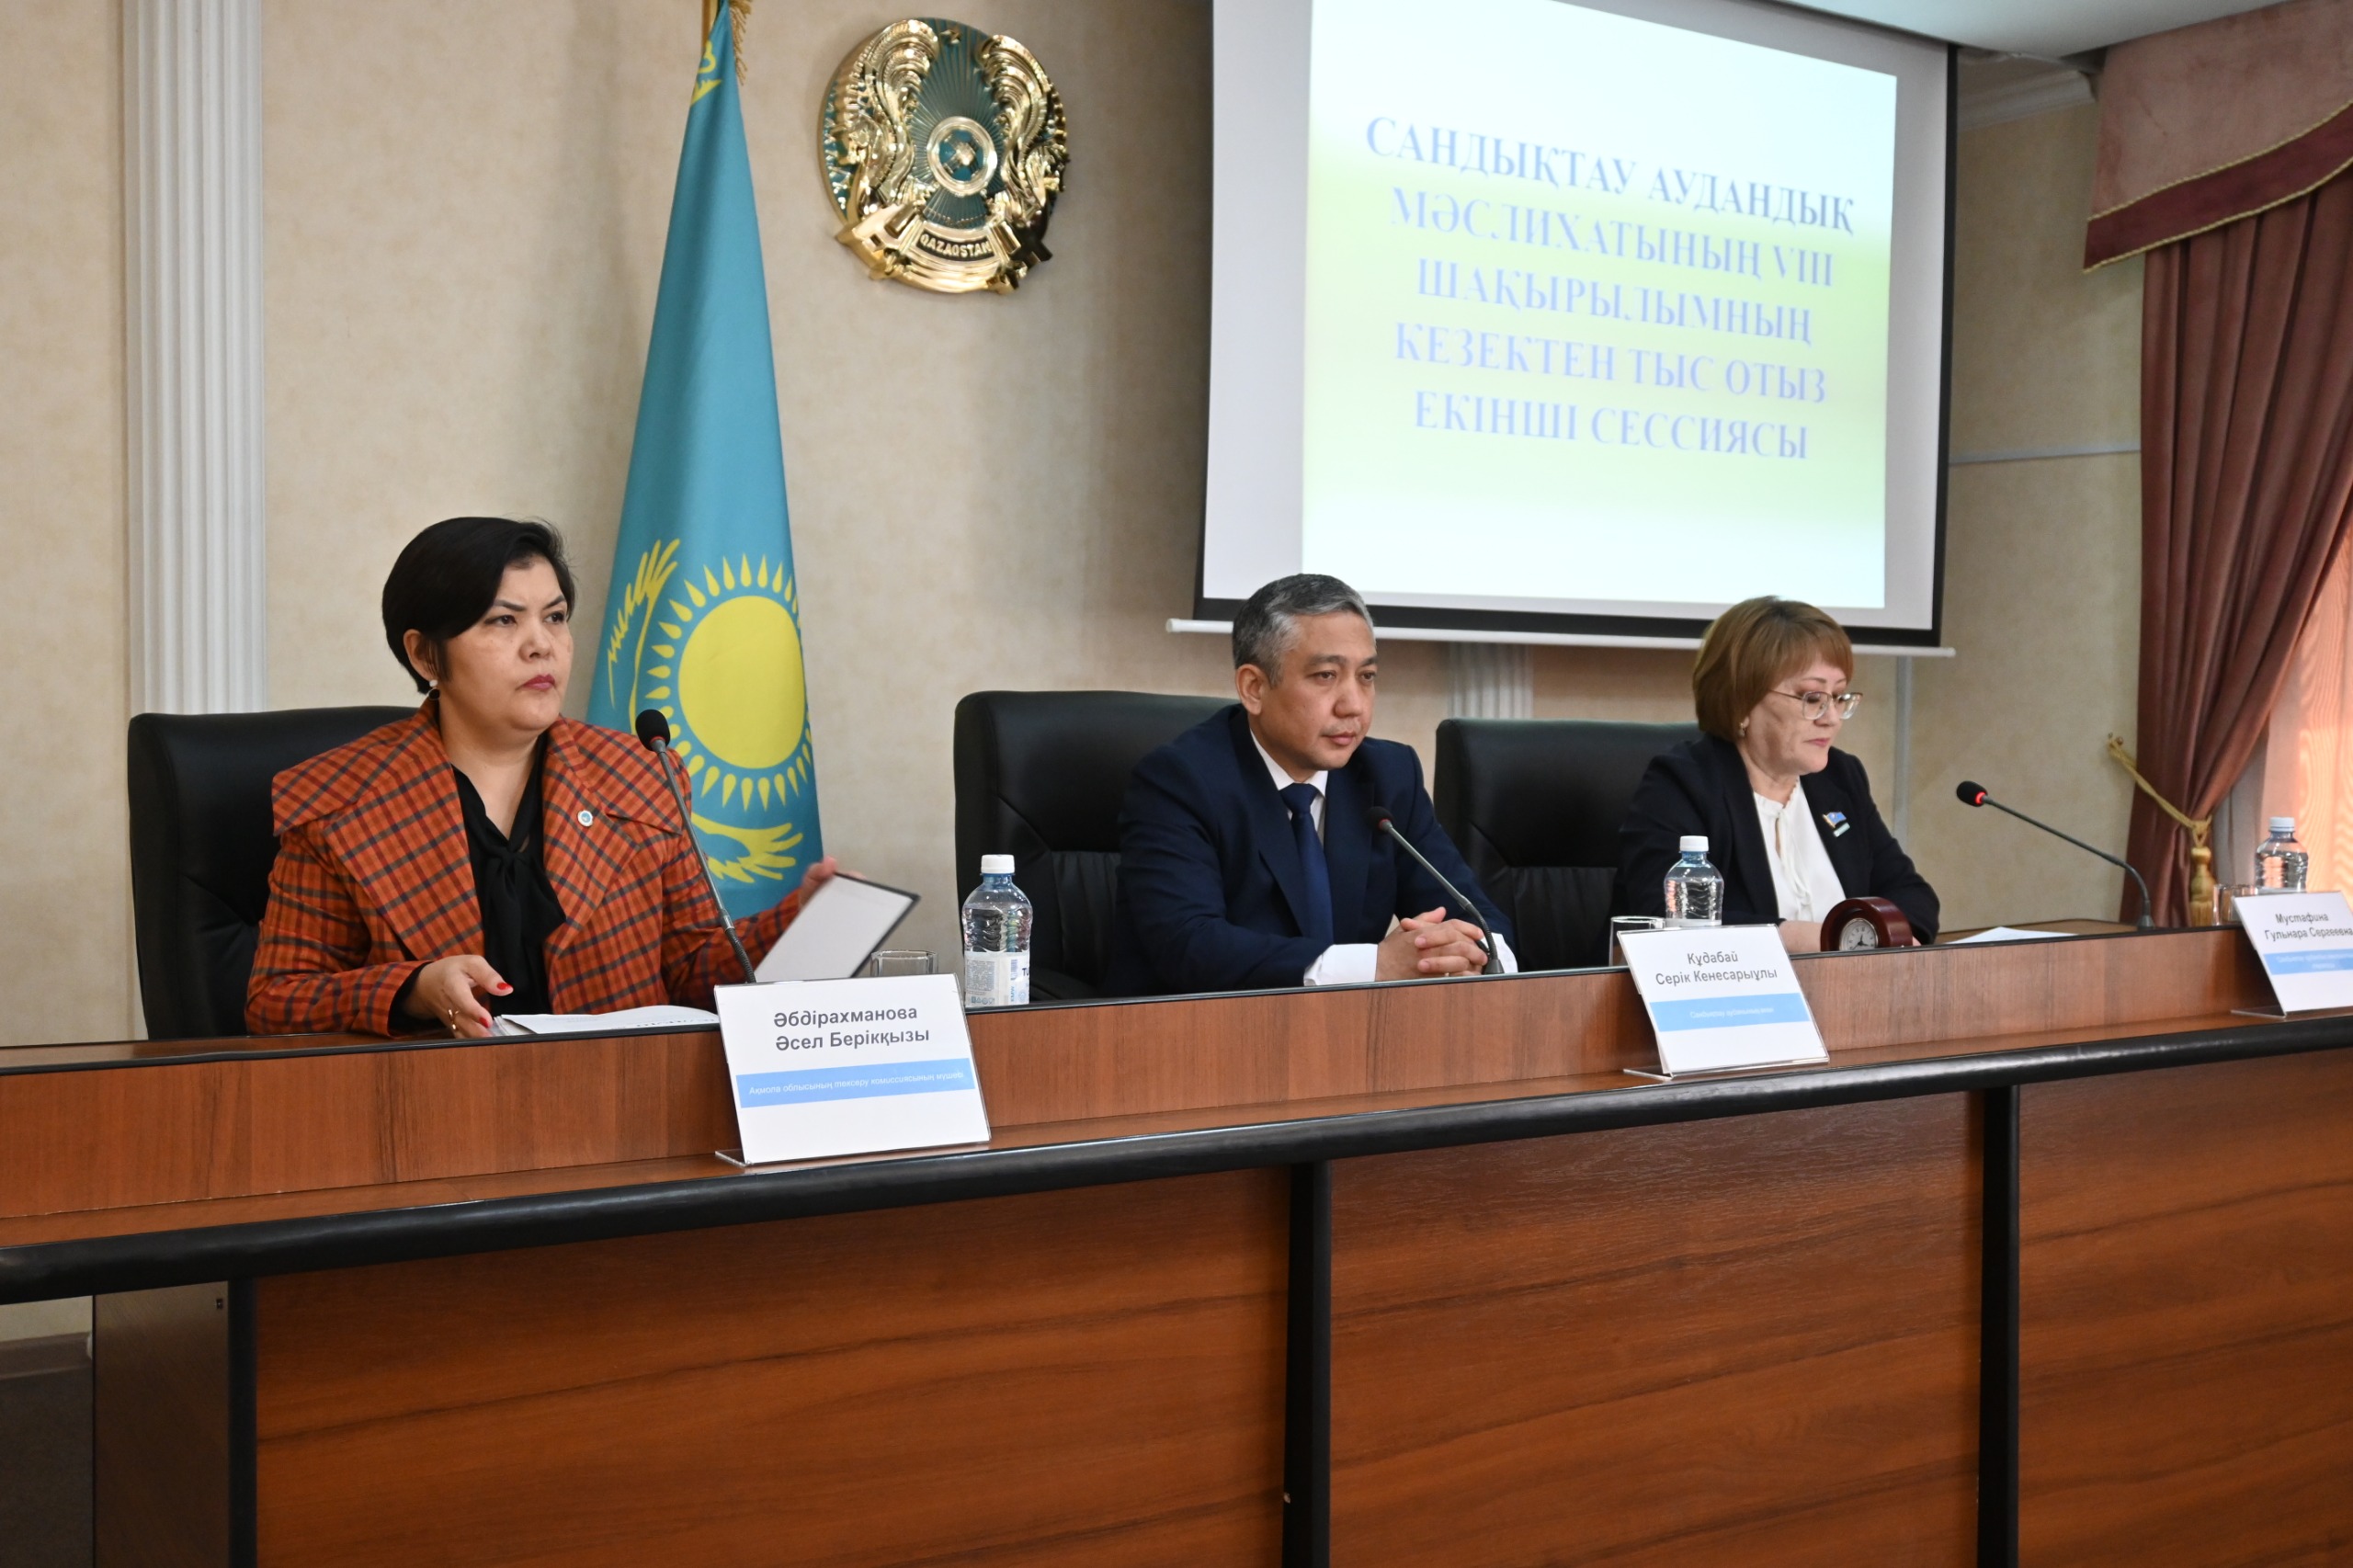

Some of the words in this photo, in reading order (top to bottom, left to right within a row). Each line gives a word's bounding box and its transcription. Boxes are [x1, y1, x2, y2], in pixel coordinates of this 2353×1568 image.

[1366, 117, 1637, 195] САНДЫҚТАУ
[1648, 166, 1855, 236] АУДАНДЫҚ
[919, 233, 993, 258] QAZAQSTAN
[1390, 187, 1762, 280] МӘСЛИХАТЫНЫҢ
[1416, 257, 1813, 347] ШАҚЫРЫЛЫМНЫҢ
[1394, 322, 1616, 381] КЕЗЕКТЕН
[1627, 348, 1715, 392] ТЫС
[1725, 359, 1827, 403] ОТЫЗ
[1414, 391, 1578, 441] ЕКІНШІ
[1591, 407, 1808, 460] СЕССИЯСЫ
[1655, 971, 1691, 987] Серік
[1693, 969, 1778, 983] Кенесарыұлы
[774, 1007, 917, 1028] Әбдірахманова
[776, 1035, 824, 1051] Әсел
[830, 1028, 929, 1050] Берікқызы
